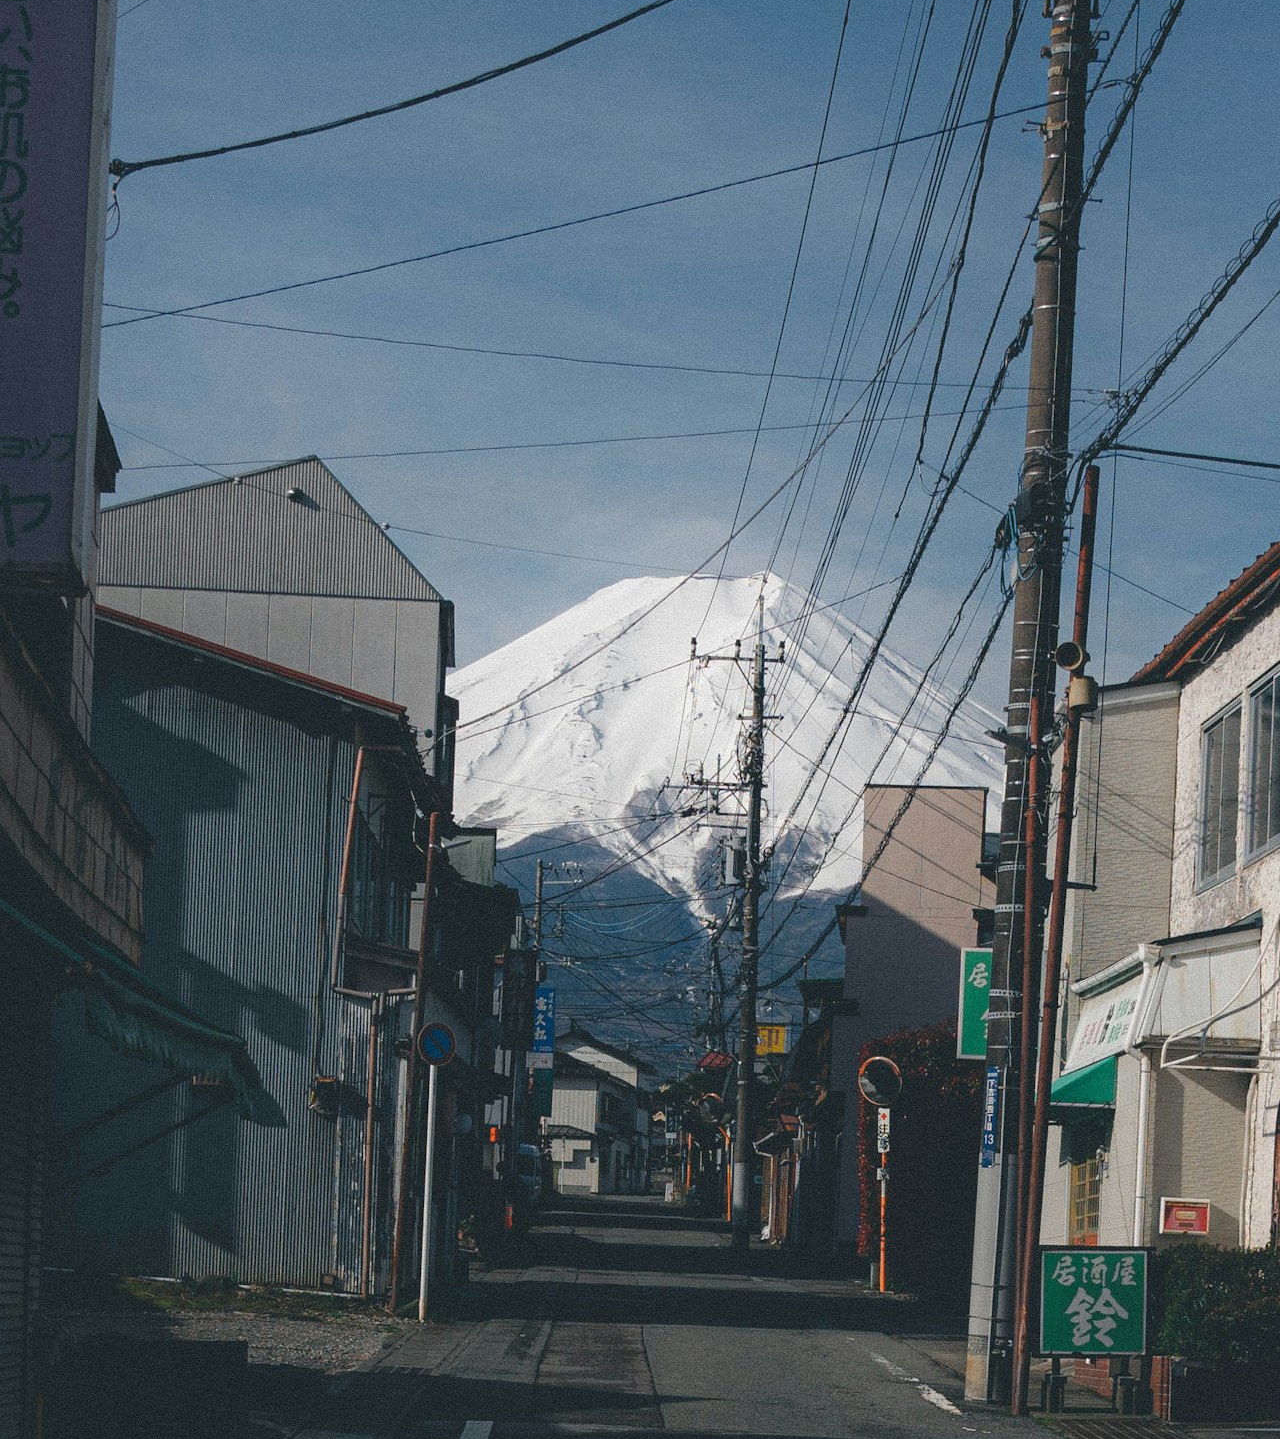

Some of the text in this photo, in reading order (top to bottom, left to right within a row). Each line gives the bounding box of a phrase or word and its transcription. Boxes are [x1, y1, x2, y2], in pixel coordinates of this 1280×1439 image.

[983, 1134, 995, 1146] 13
[1052, 1255, 1138, 1287] 居酒屋
[1064, 1286, 1130, 1349] 鈴
